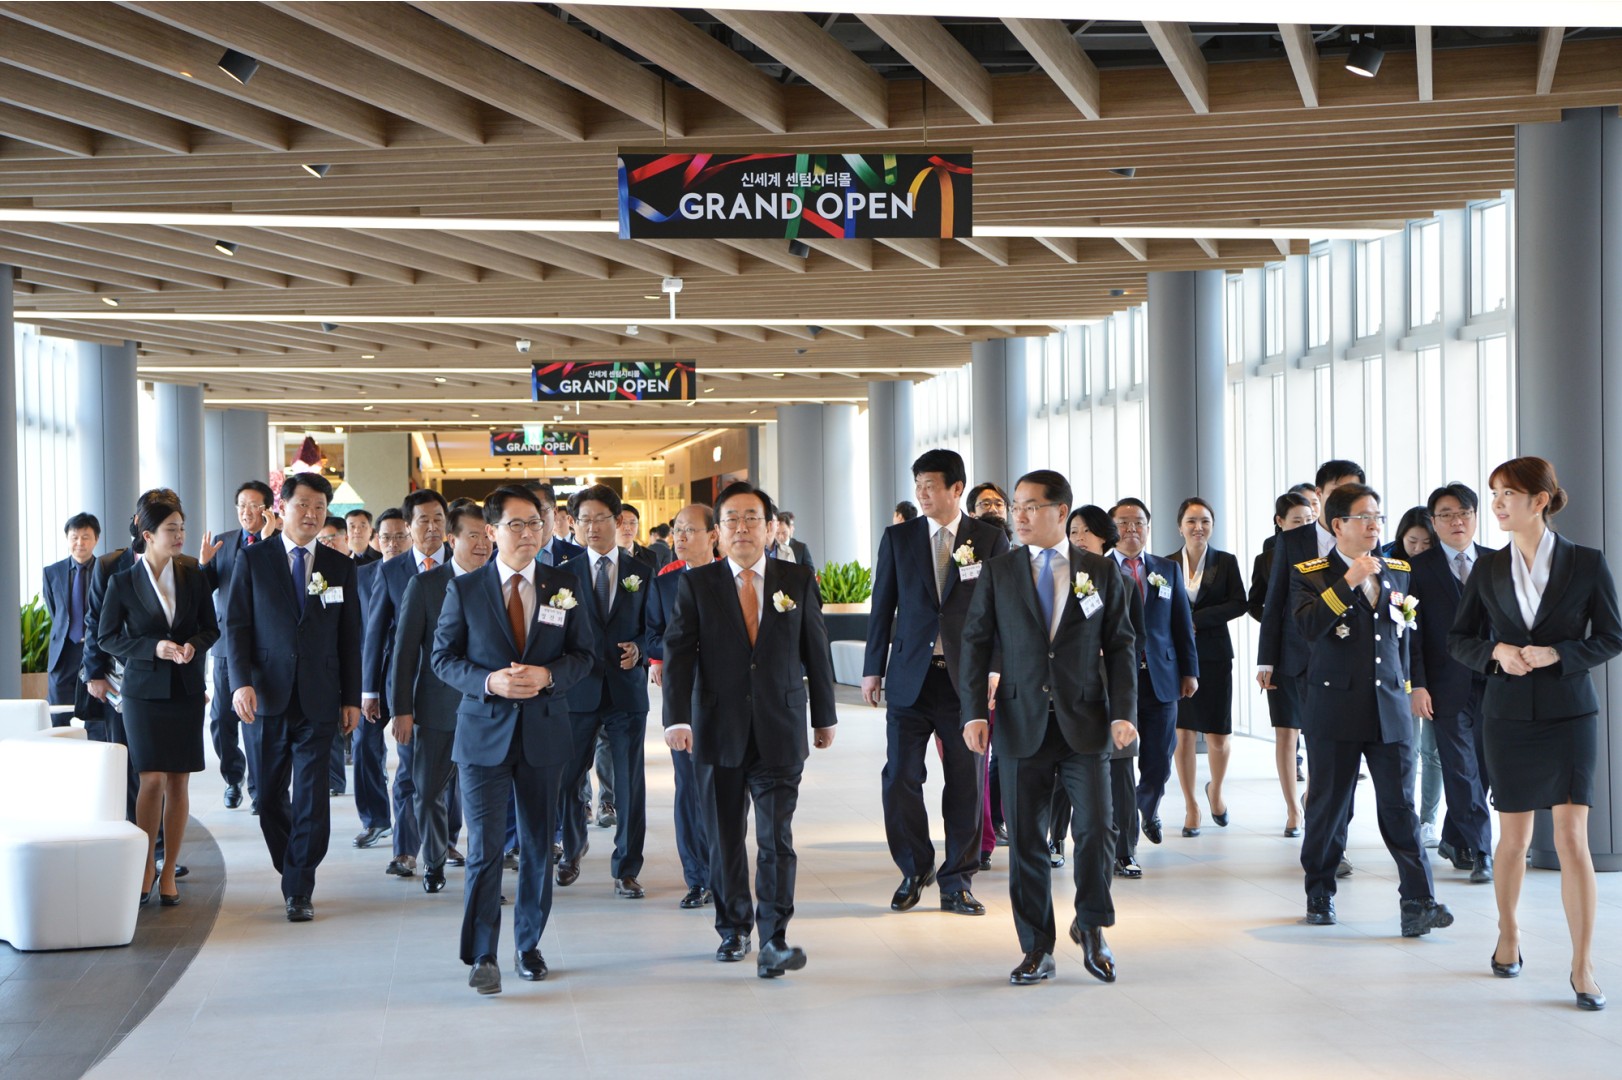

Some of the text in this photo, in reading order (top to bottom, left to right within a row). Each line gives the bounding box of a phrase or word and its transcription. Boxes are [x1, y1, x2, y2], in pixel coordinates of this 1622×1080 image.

[741, 172, 852, 187] 신세계 센텀시티몰
[679, 192, 914, 220] GRAND OPEN
[588, 370, 608, 378] 신세계
[559, 379, 670, 393] GRAND OPEN
[506, 442, 574, 452] GRAND OPEN
